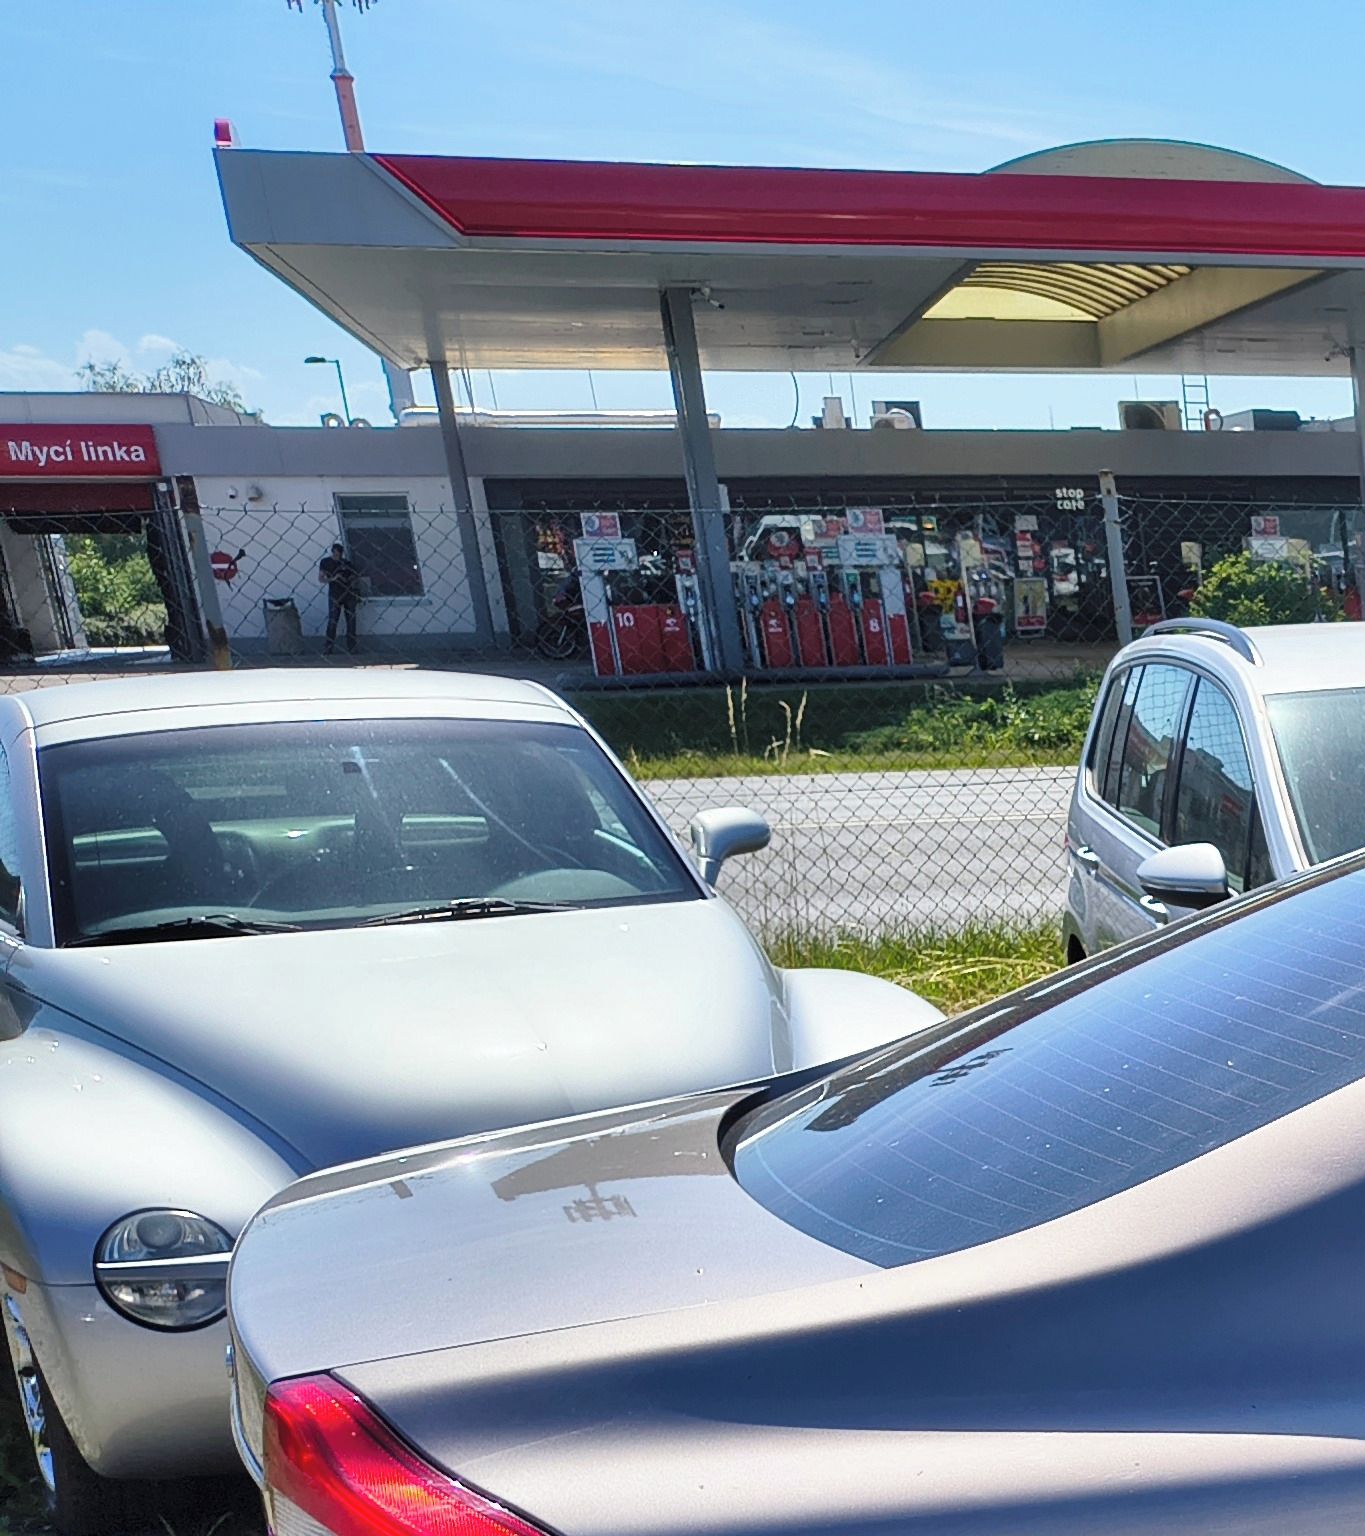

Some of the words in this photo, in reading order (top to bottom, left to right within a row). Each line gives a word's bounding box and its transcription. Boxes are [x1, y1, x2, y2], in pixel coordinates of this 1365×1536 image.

[7, 439, 73, 467] Mycí
[80, 441, 146, 461] linka
[1055, 487, 1085, 500] stop
[616, 612, 634, 628] 10
